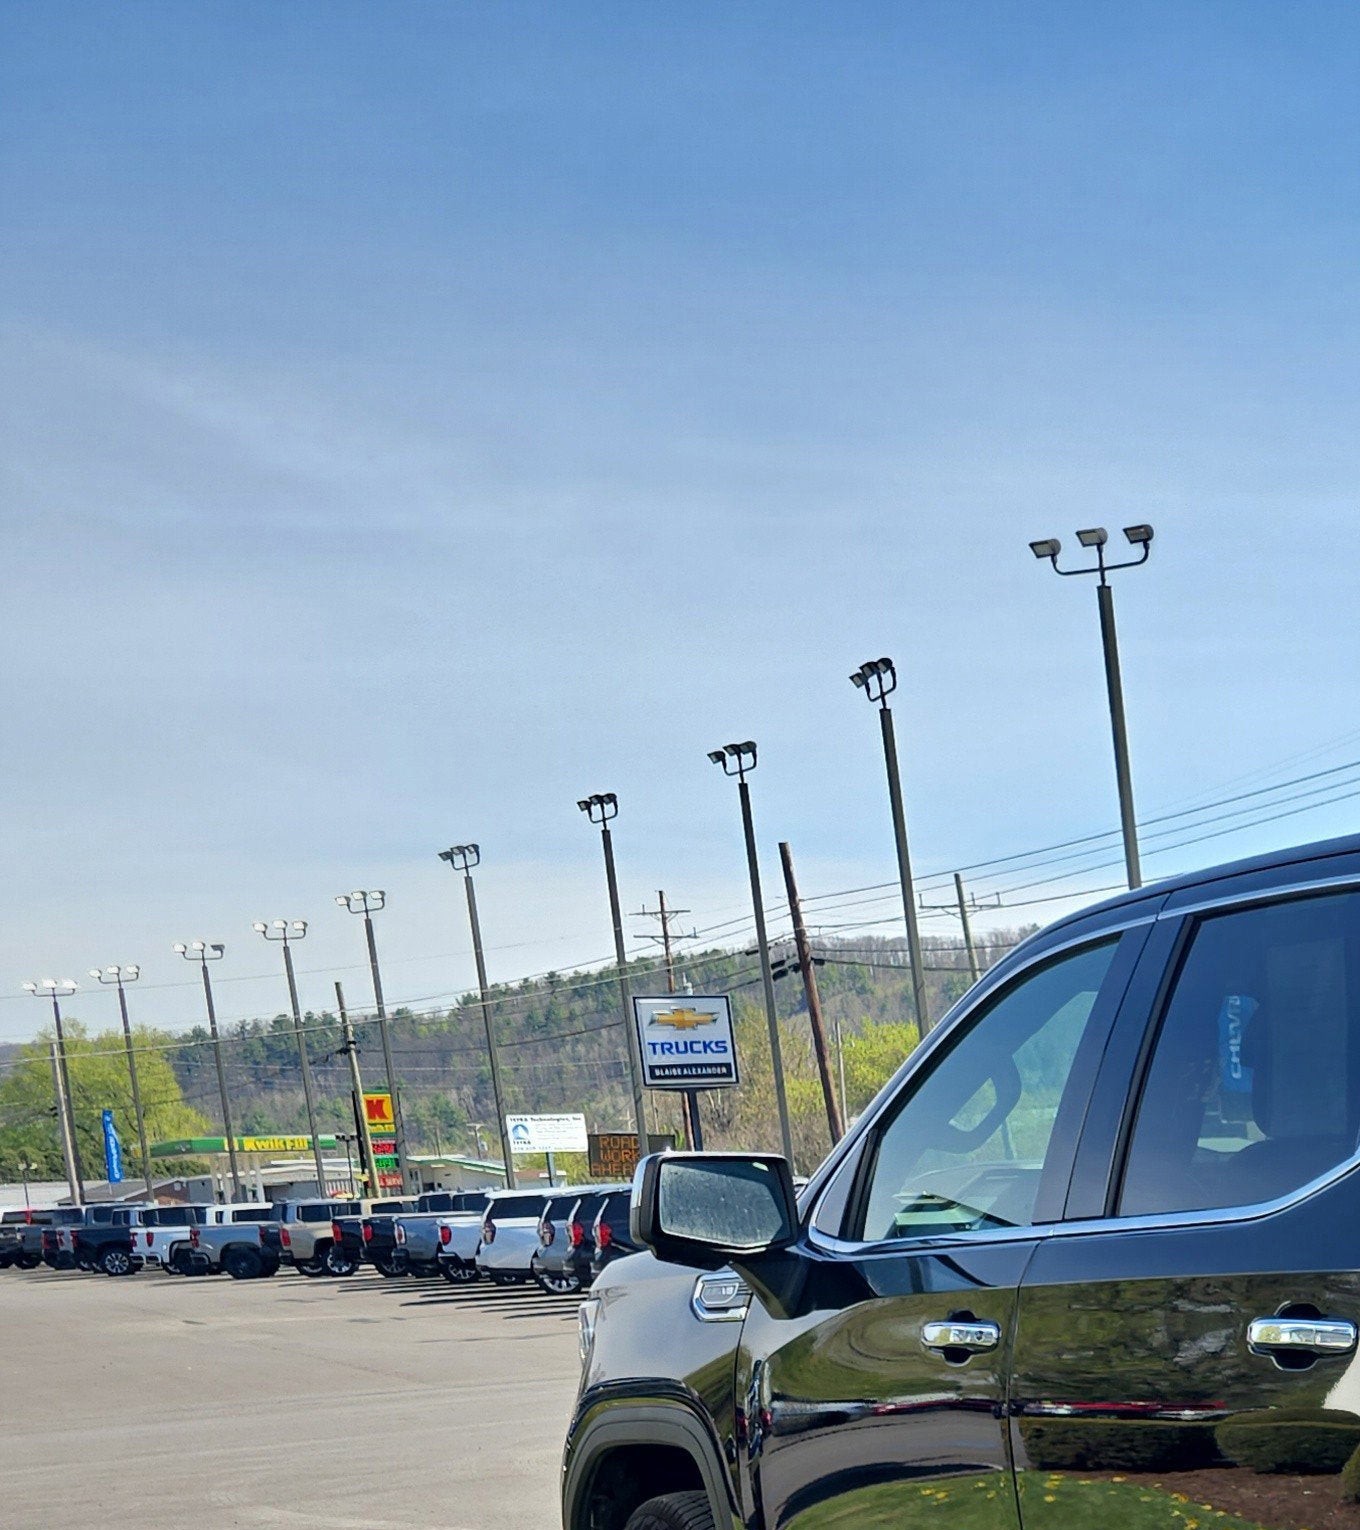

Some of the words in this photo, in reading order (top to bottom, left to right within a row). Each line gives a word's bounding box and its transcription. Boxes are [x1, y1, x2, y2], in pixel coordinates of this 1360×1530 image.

[647, 1040, 728, 1056] TRUCKS
[654, 1066, 681, 1077] BLAISE
[683, 1065, 727, 1076] ALEXANDER
[365, 1099, 389, 1120] K
[244, 1137, 285, 1151] Kwik
[286, 1136, 308, 1151] Fill
[591, 1162, 638, 1176] AHEA
